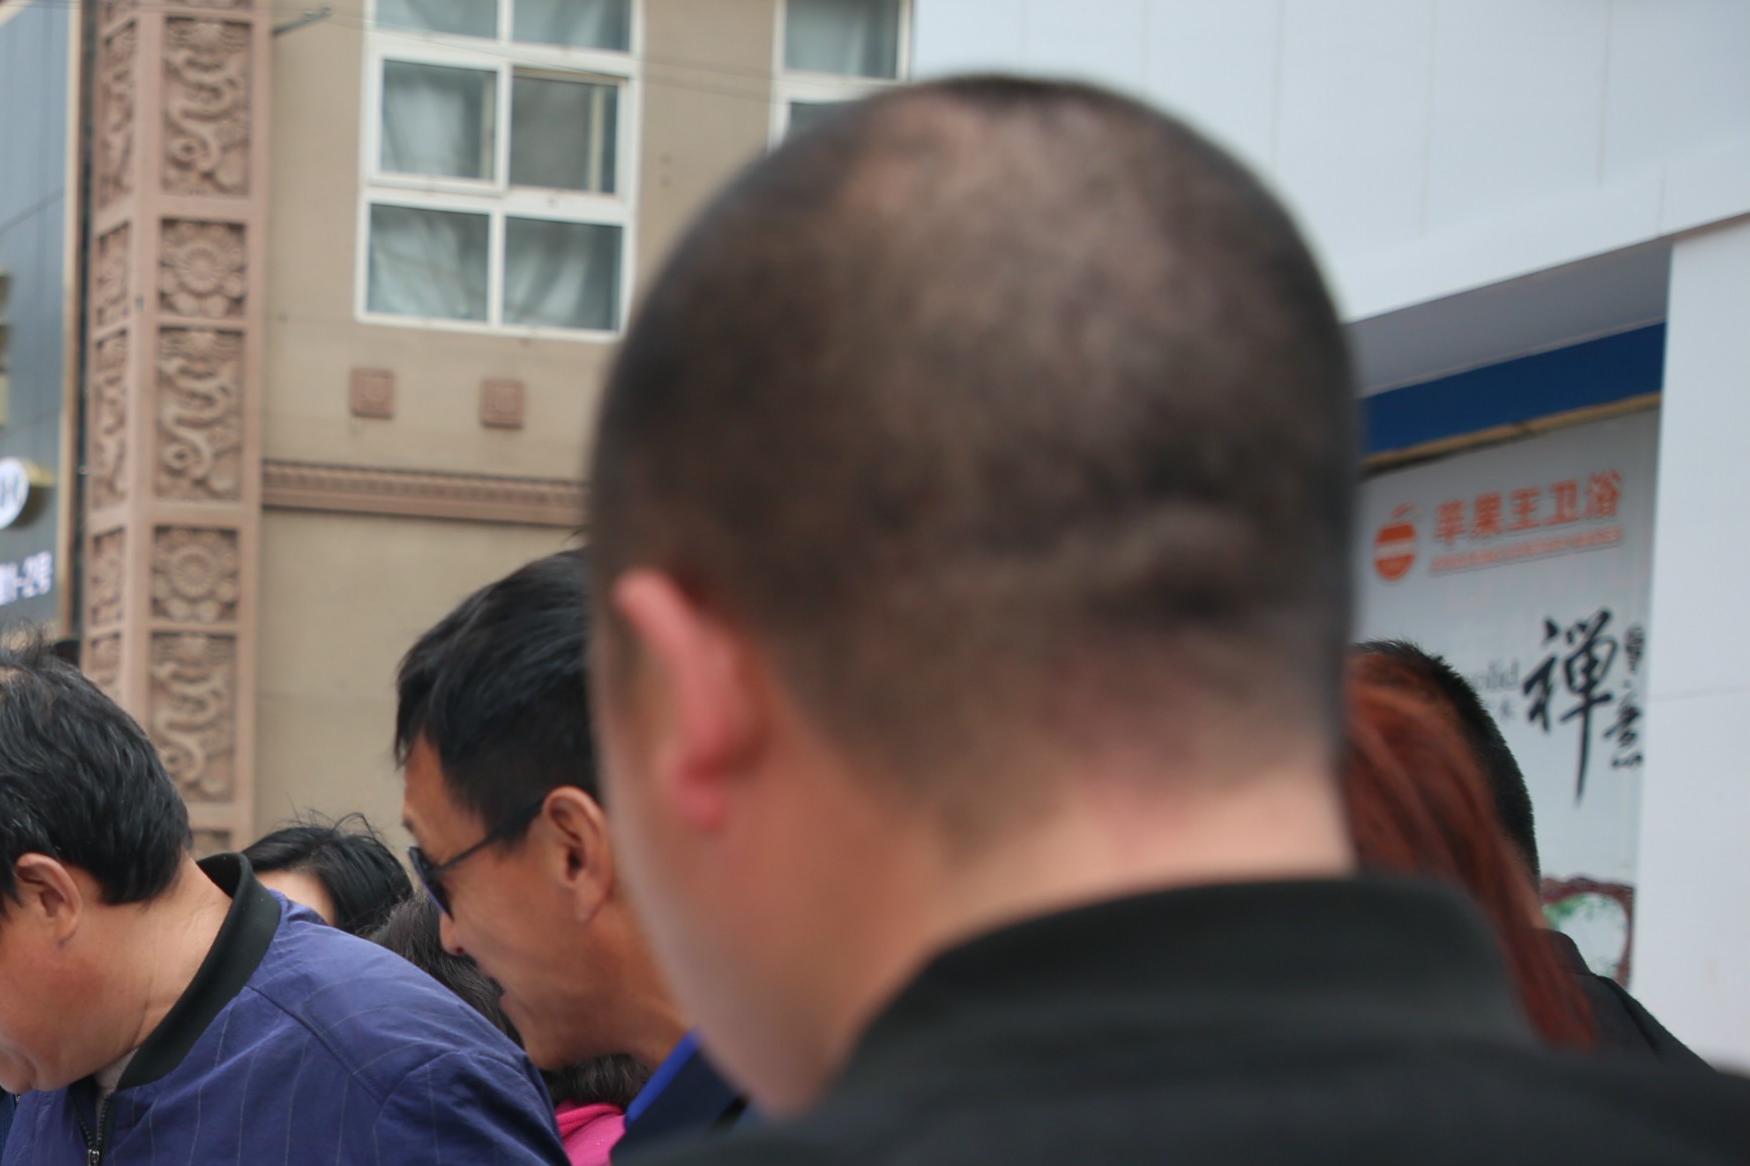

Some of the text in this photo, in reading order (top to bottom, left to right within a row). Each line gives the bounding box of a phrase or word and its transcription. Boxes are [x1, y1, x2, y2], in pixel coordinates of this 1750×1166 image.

[1433, 469, 1623, 545] 苹果王卫浴
